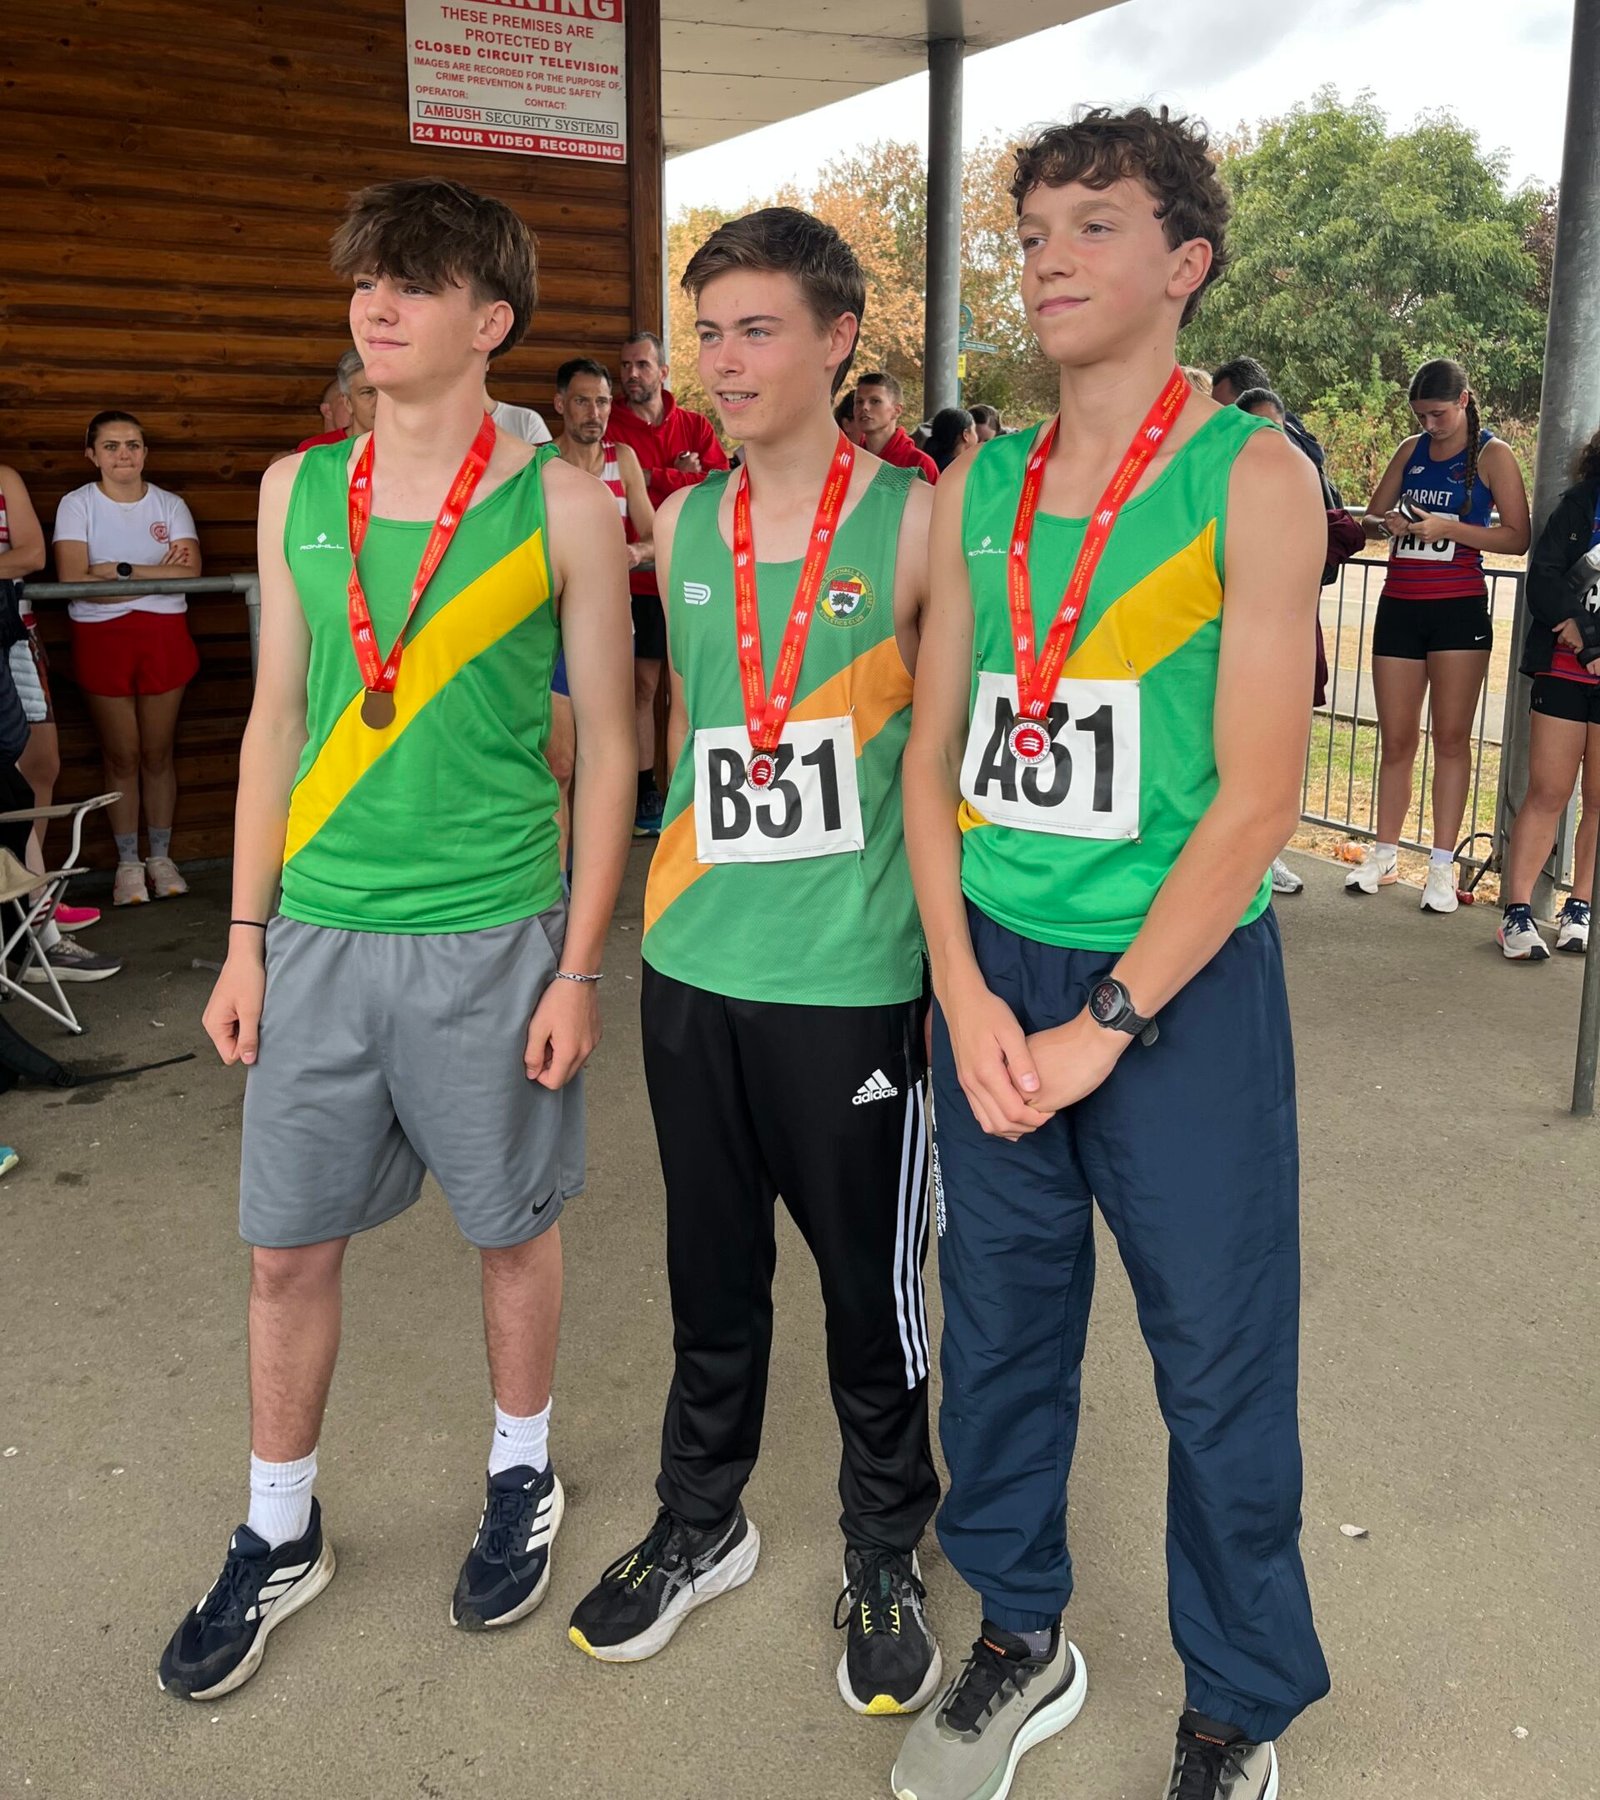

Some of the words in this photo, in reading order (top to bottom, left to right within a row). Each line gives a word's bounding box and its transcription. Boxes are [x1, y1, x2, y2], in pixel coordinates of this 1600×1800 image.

[441, 6, 488, 24] THESE
[492, 13, 563, 35] PREMISES
[566, 24, 594, 39] ARE
[465, 28, 550, 51] PROTECTED
[554, 40, 572, 54] BY
[414, 39, 471, 56] CLOSED
[477, 47, 534, 64] CIRCUIT
[539, 56, 619, 75] TELEVISION
[414, 57, 450, 69] IMAGES
[452, 62, 471, 72] ARE
[474, 64, 524, 78] RECORDED
[526, 70, 544, 80] FOR
[546, 73, 564, 83] THE
[566, 76, 606, 89] PURPOSE
[435, 71, 464, 83] CRIME
[467, 75, 524, 90] PREVENTION
[525, 83, 532, 91] &
[535, 83, 567, 95] PUBLIC
[568, 88, 601, 99] SAFETY
[415, 85, 469, 99] OPERATOR:
[524, 98, 567, 110] CONTACT:
[424, 105, 481, 120] AMBUSH
[485, 111, 551, 129] SECURITY
[555, 119, 614, 135] SYSTEMS
[415, 126, 434, 138] 24
[440, 129, 483, 143] HOUR
[488, 133, 534, 148] VIDEO
[540, 139, 622, 157] RECORDING
[1010, 723, 1035, 748] MIDDLESEX
[1036, 725, 1050, 752] COUNTY
[973, 696, 1115, 813] A31
[1012, 749, 1046, 763] ATHLETICS
[708, 738, 842, 841] B31
[852, 1086, 898, 1105] adidas
